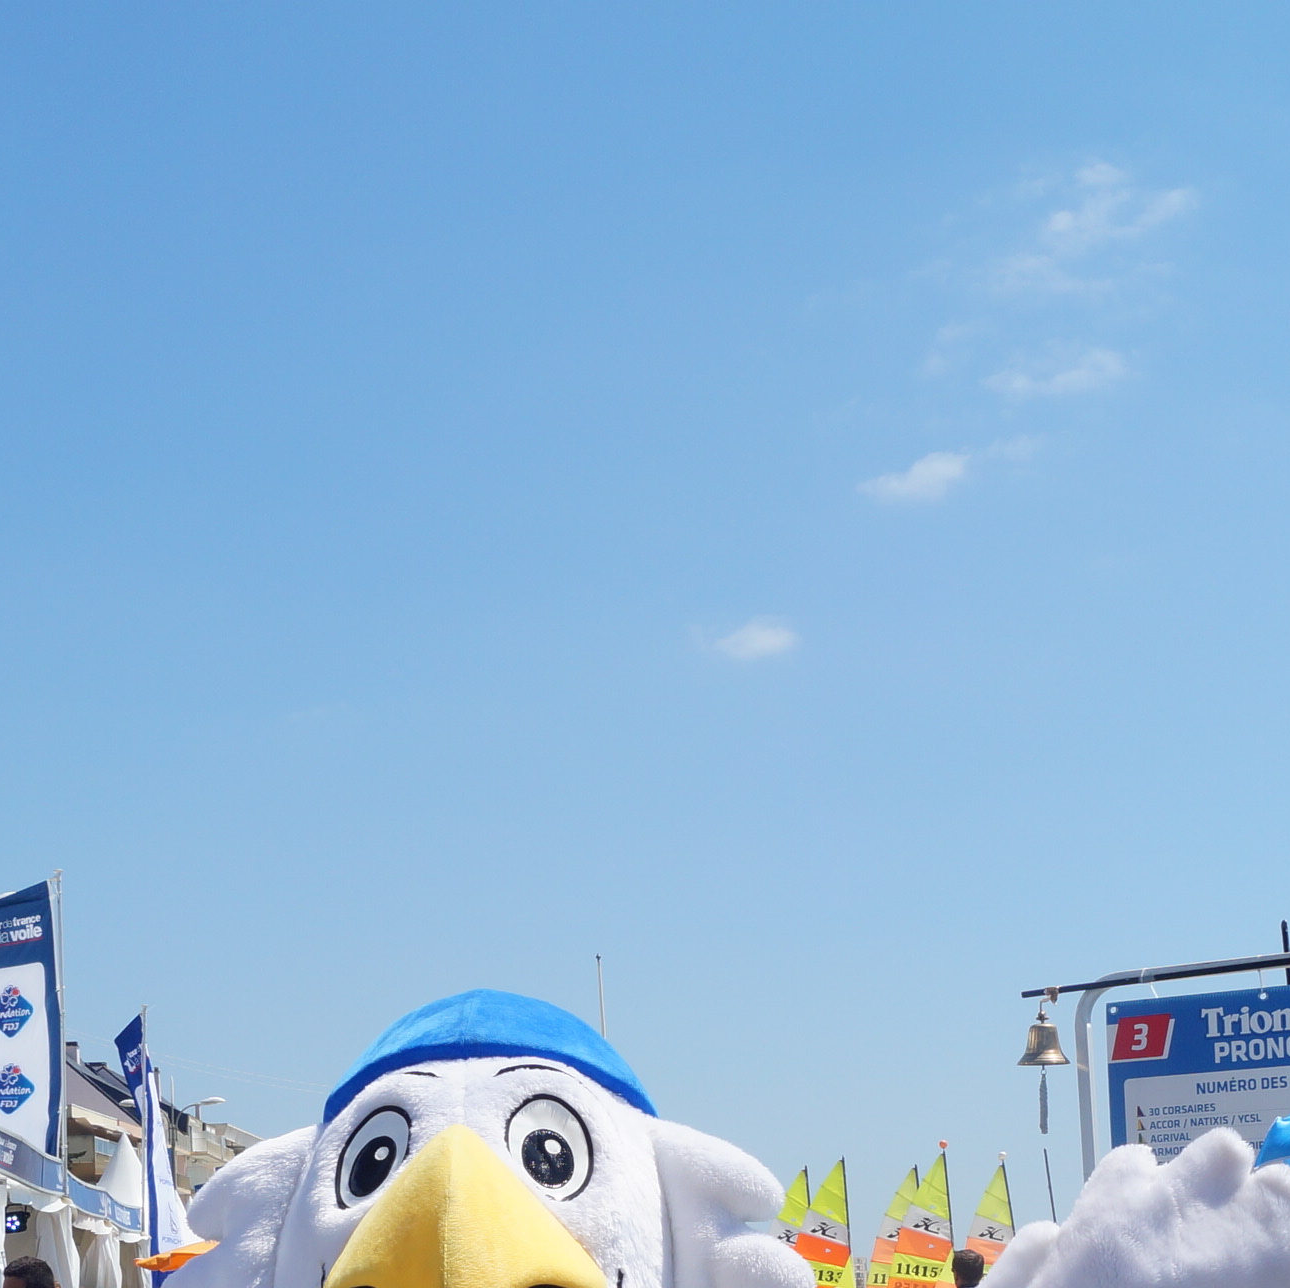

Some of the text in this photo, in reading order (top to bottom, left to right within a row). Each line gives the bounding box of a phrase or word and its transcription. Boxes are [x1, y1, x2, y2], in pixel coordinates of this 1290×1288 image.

[13, 915, 41, 926] france
[10, 924, 42, 942] voile
[2, 1022, 19, 1031] FDJ
[1131, 1023, 1149, 1050] 3
[1196, 1077, 1257, 1094] NUMÉRO
[1261, 1076, 1287, 1090] DES
[1149, 1103, 1216, 1116] 30 CORSAIRES
[1150, 1113, 1262, 1130] ACCOR NATIXIS YCSL
[1150, 1132, 1191, 1143] AGRIVAL
